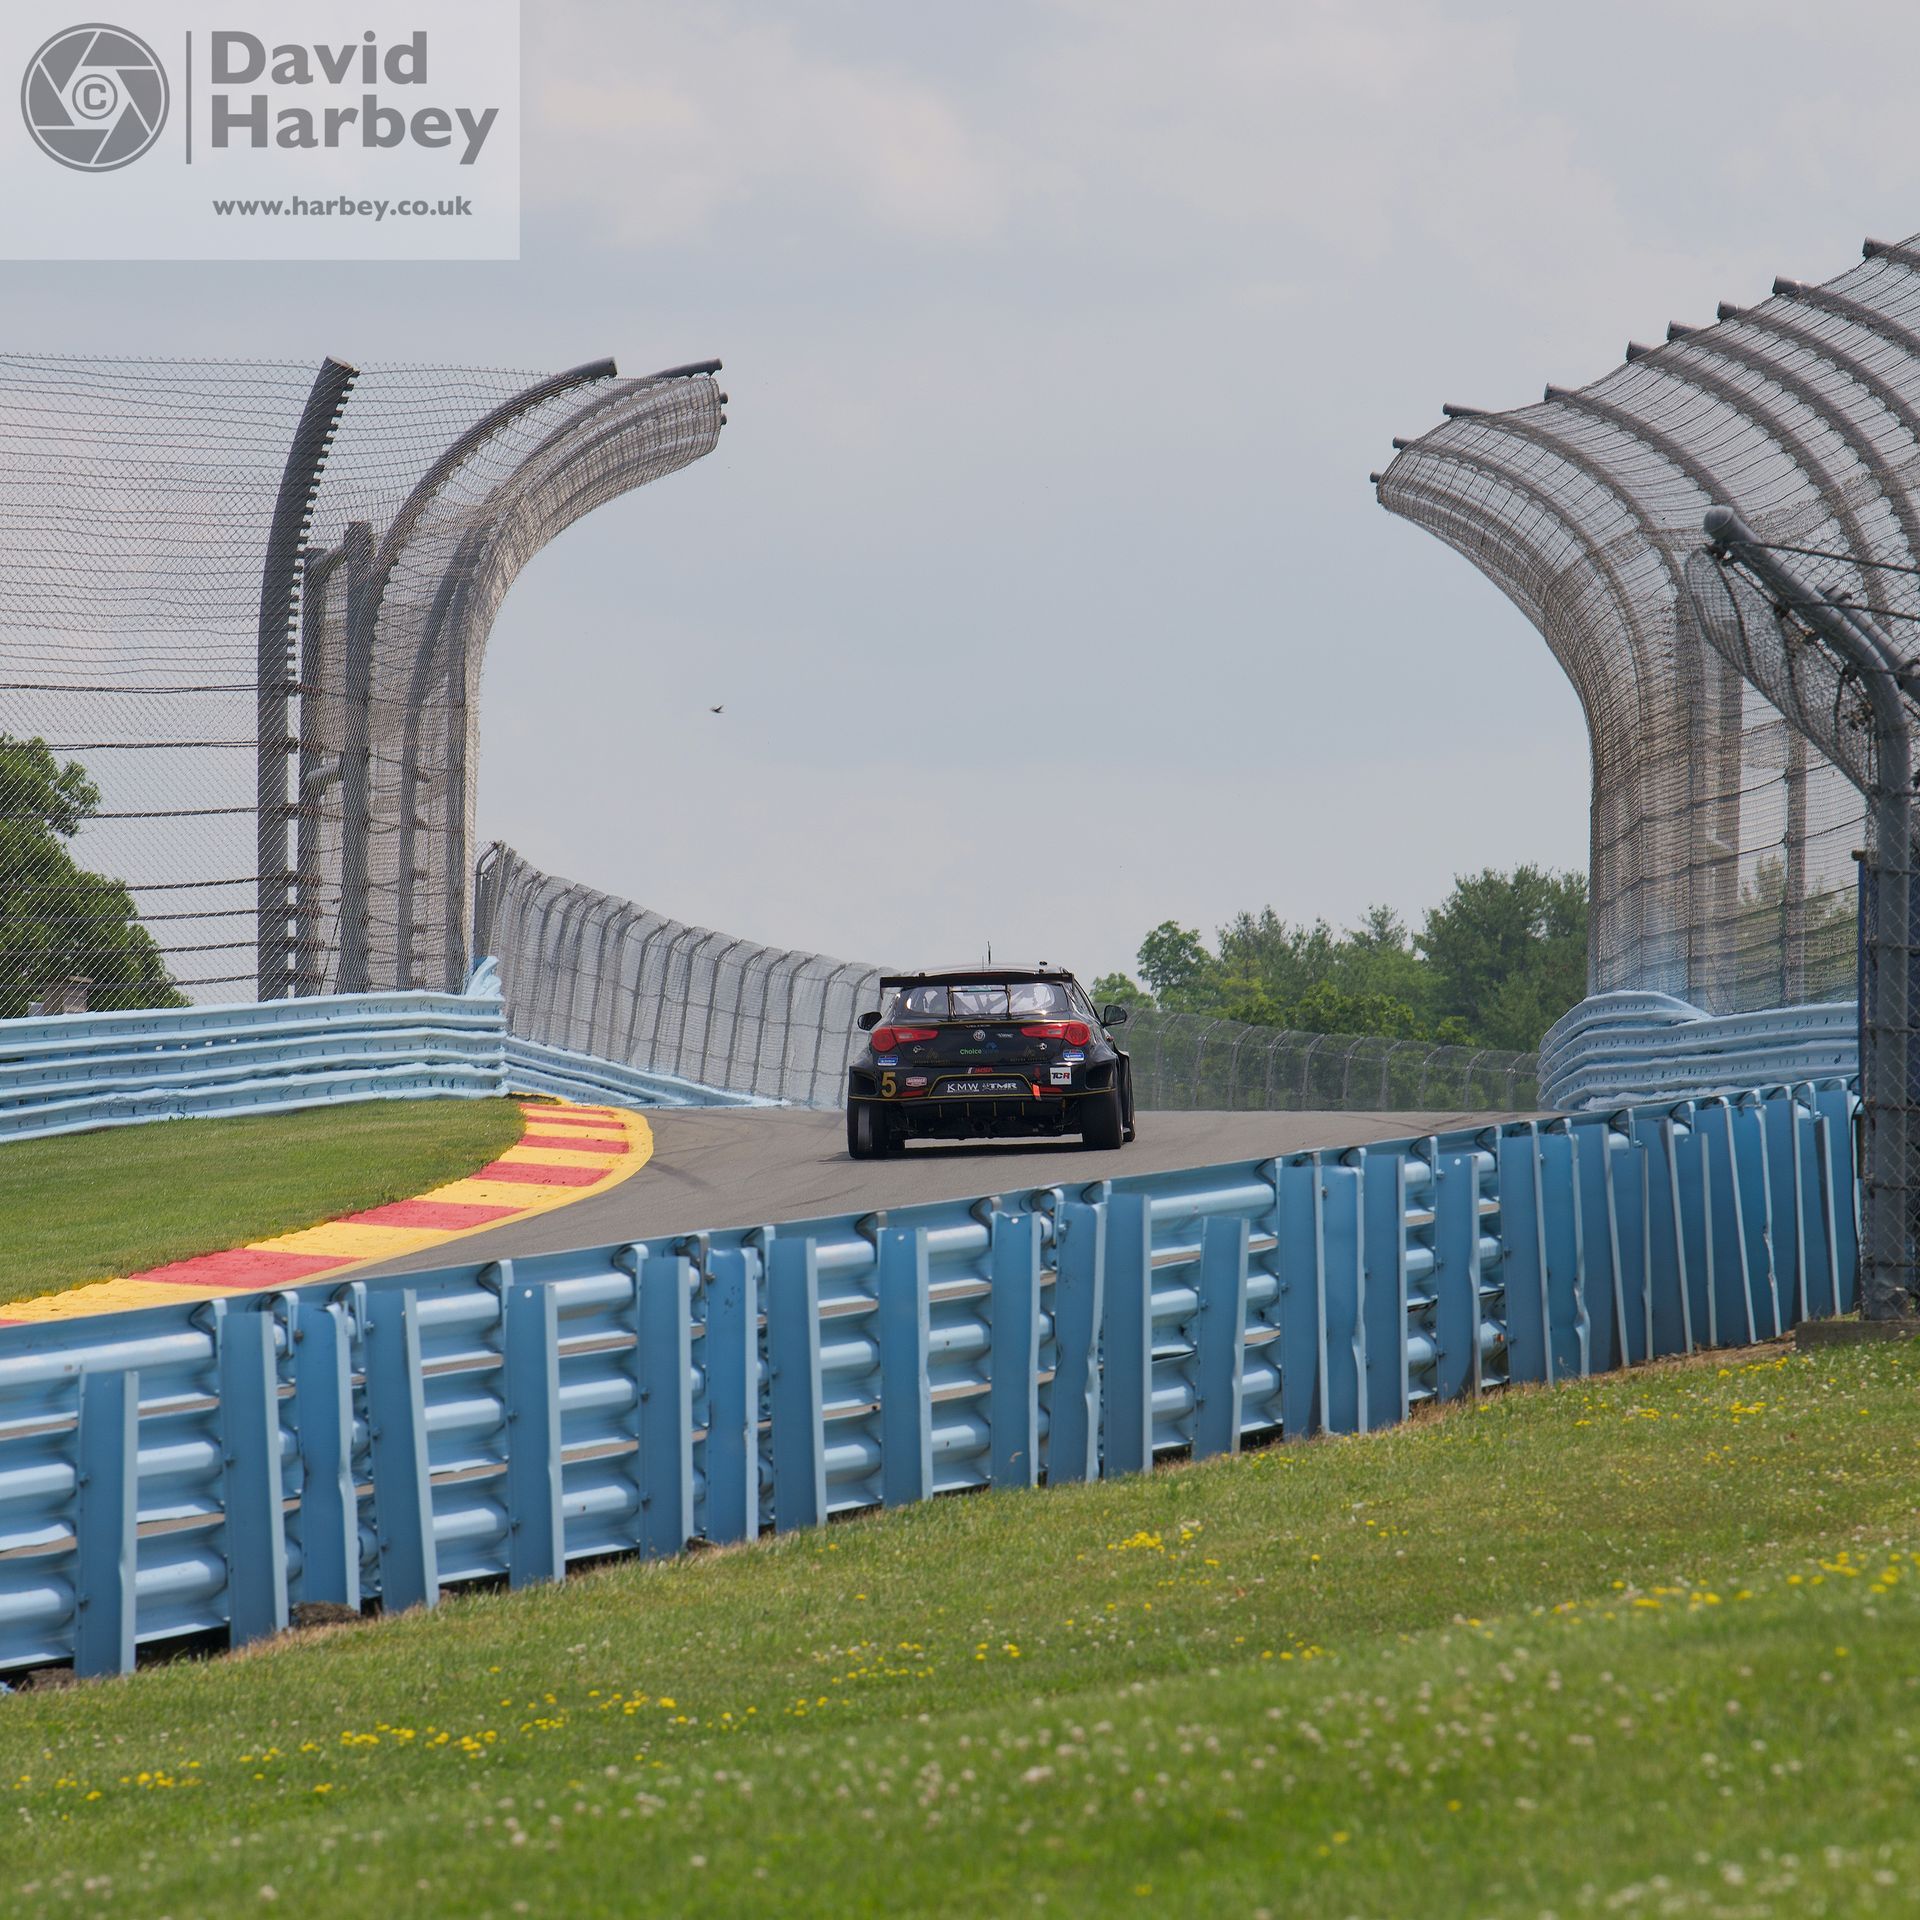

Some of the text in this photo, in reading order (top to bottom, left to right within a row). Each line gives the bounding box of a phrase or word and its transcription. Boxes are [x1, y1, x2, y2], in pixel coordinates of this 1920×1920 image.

[959, 1047, 982, 1055] Choice
[1051, 1072, 1070, 1080] TCR
[881, 1071, 897, 1098] 5
[947, 1083, 979, 1092] KMW
